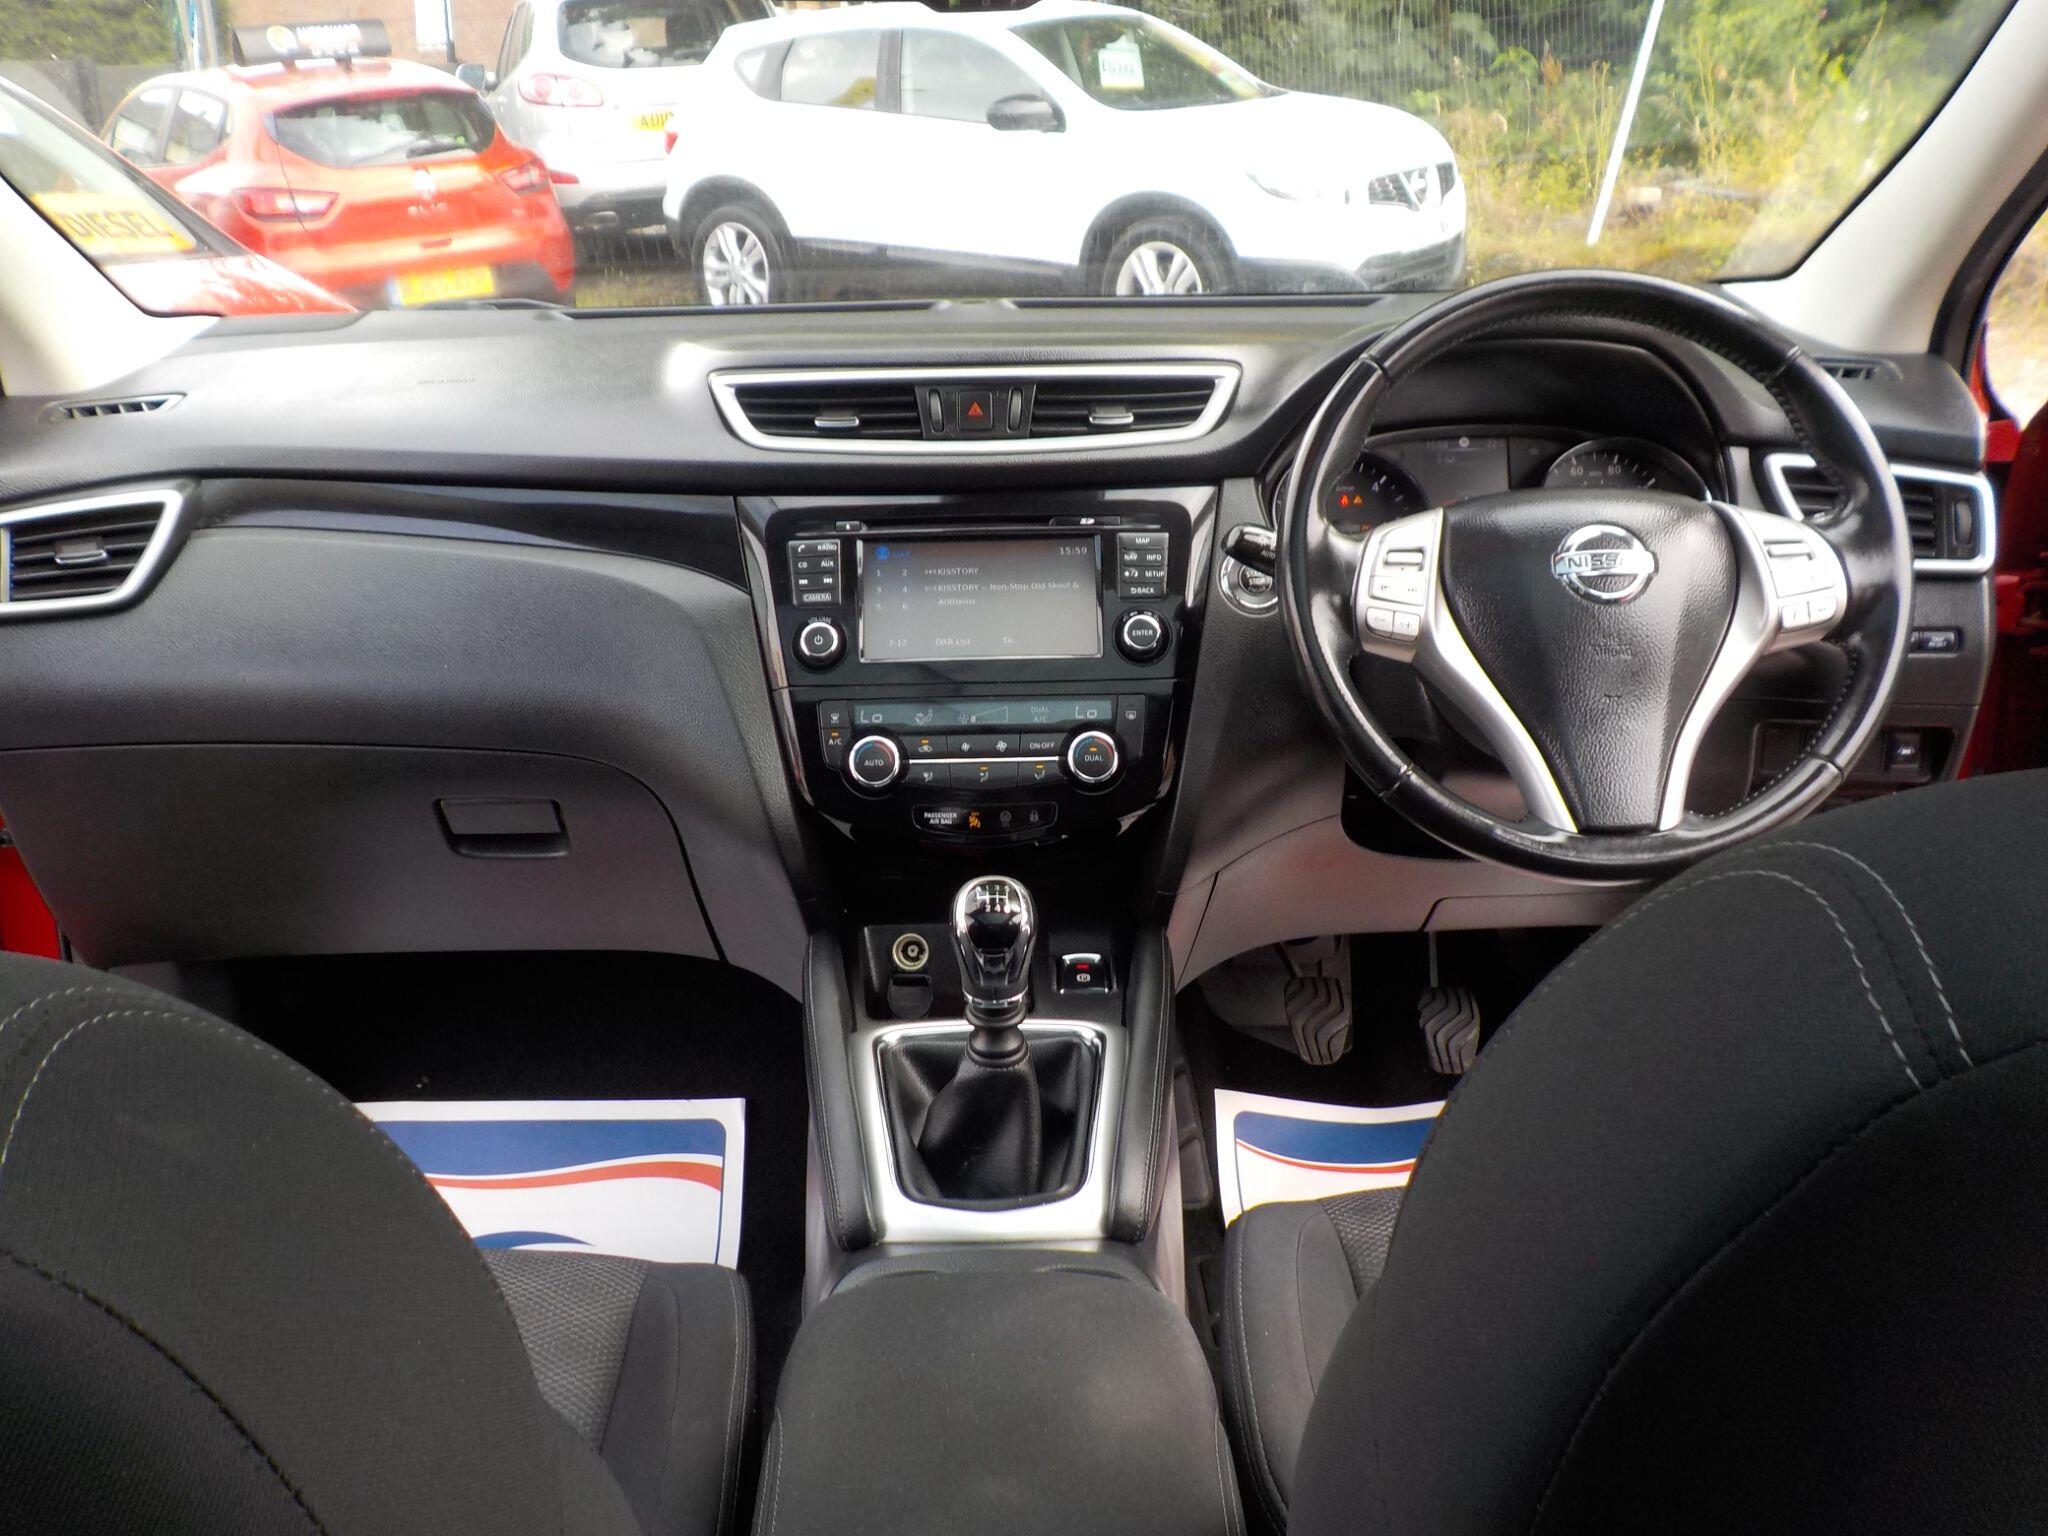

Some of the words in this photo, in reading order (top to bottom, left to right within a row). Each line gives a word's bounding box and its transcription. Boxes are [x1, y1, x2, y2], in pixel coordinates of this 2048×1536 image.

[55, 210, 173, 237] DIESEL
[1570, 466, 1584, 476] 60
[1608, 465, 1622, 475] 80
[1135, 537, 1150, 545] MAP
[817, 543, 837, 551] RADIO
[1059, 546, 1088, 556] 15:59
[1123, 552, 1138, 560] NAV
[1146, 553, 1162, 561] INFO
[902, 569, 908, 577] 2
[937, 567, 979, 577] KISSTORY
[1144, 569, 1165, 577] SETUP
[803, 593, 832, 602] CAMERA
[1131, 629, 1154, 637] ENTER
[935, 638, 954, 646] DAB
[1084, 754, 1104, 762] DUAL
[864, 759, 884, 767] AUTO
